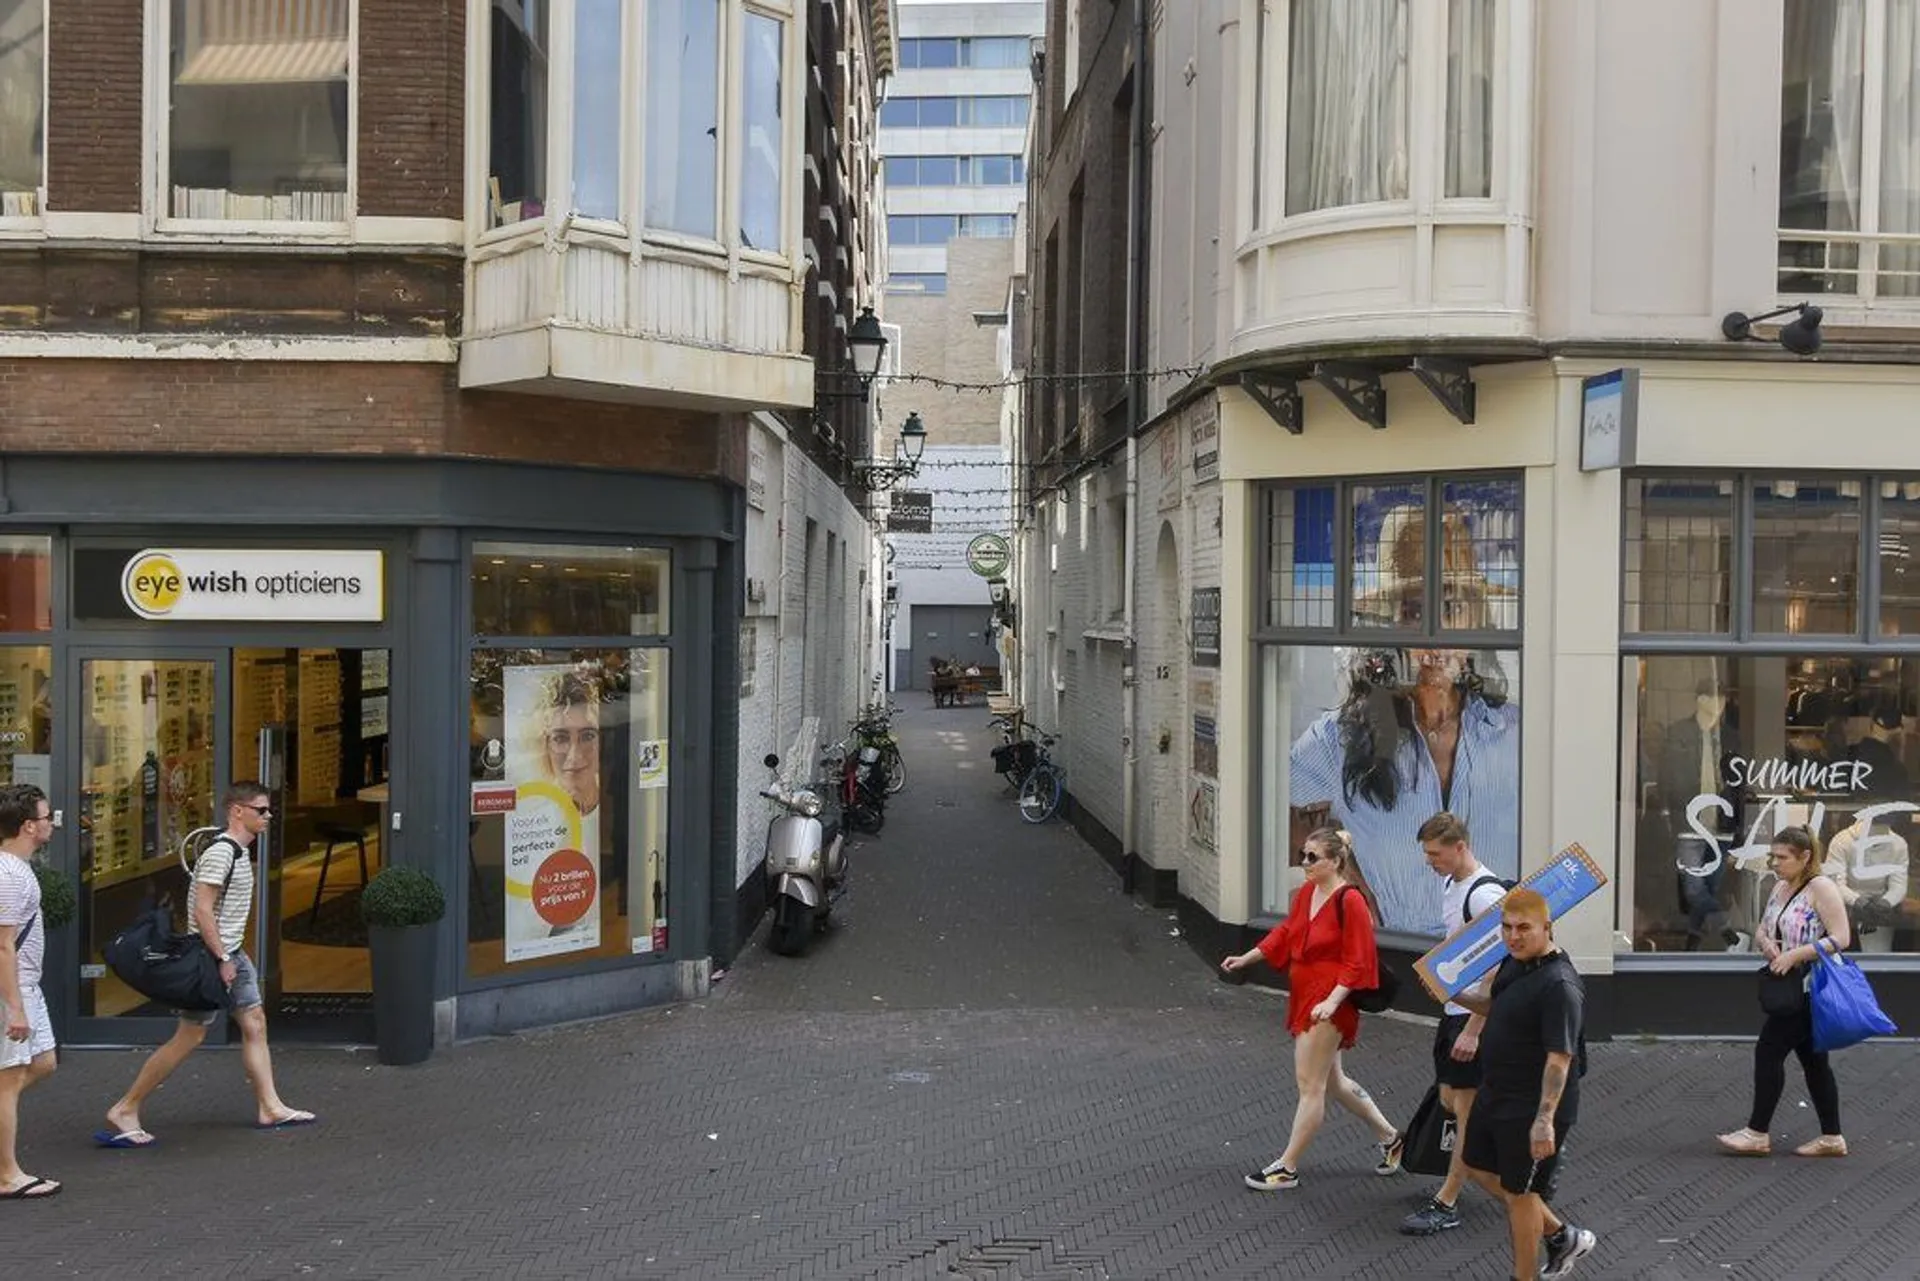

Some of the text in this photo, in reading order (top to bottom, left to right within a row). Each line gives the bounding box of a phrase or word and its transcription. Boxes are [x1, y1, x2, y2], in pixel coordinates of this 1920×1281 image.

[136, 570, 361, 599] eye wish opticiens
[1726, 756, 1873, 791] SUMMER
[554, 826, 568, 836] de
[511, 840, 556, 855] perfecte
[511, 855, 529, 866] bril
[553, 873, 561, 883] 2
[560, 869, 591, 882] brillen
[540, 895, 562, 907] prijs
[562, 891, 581, 902] van
